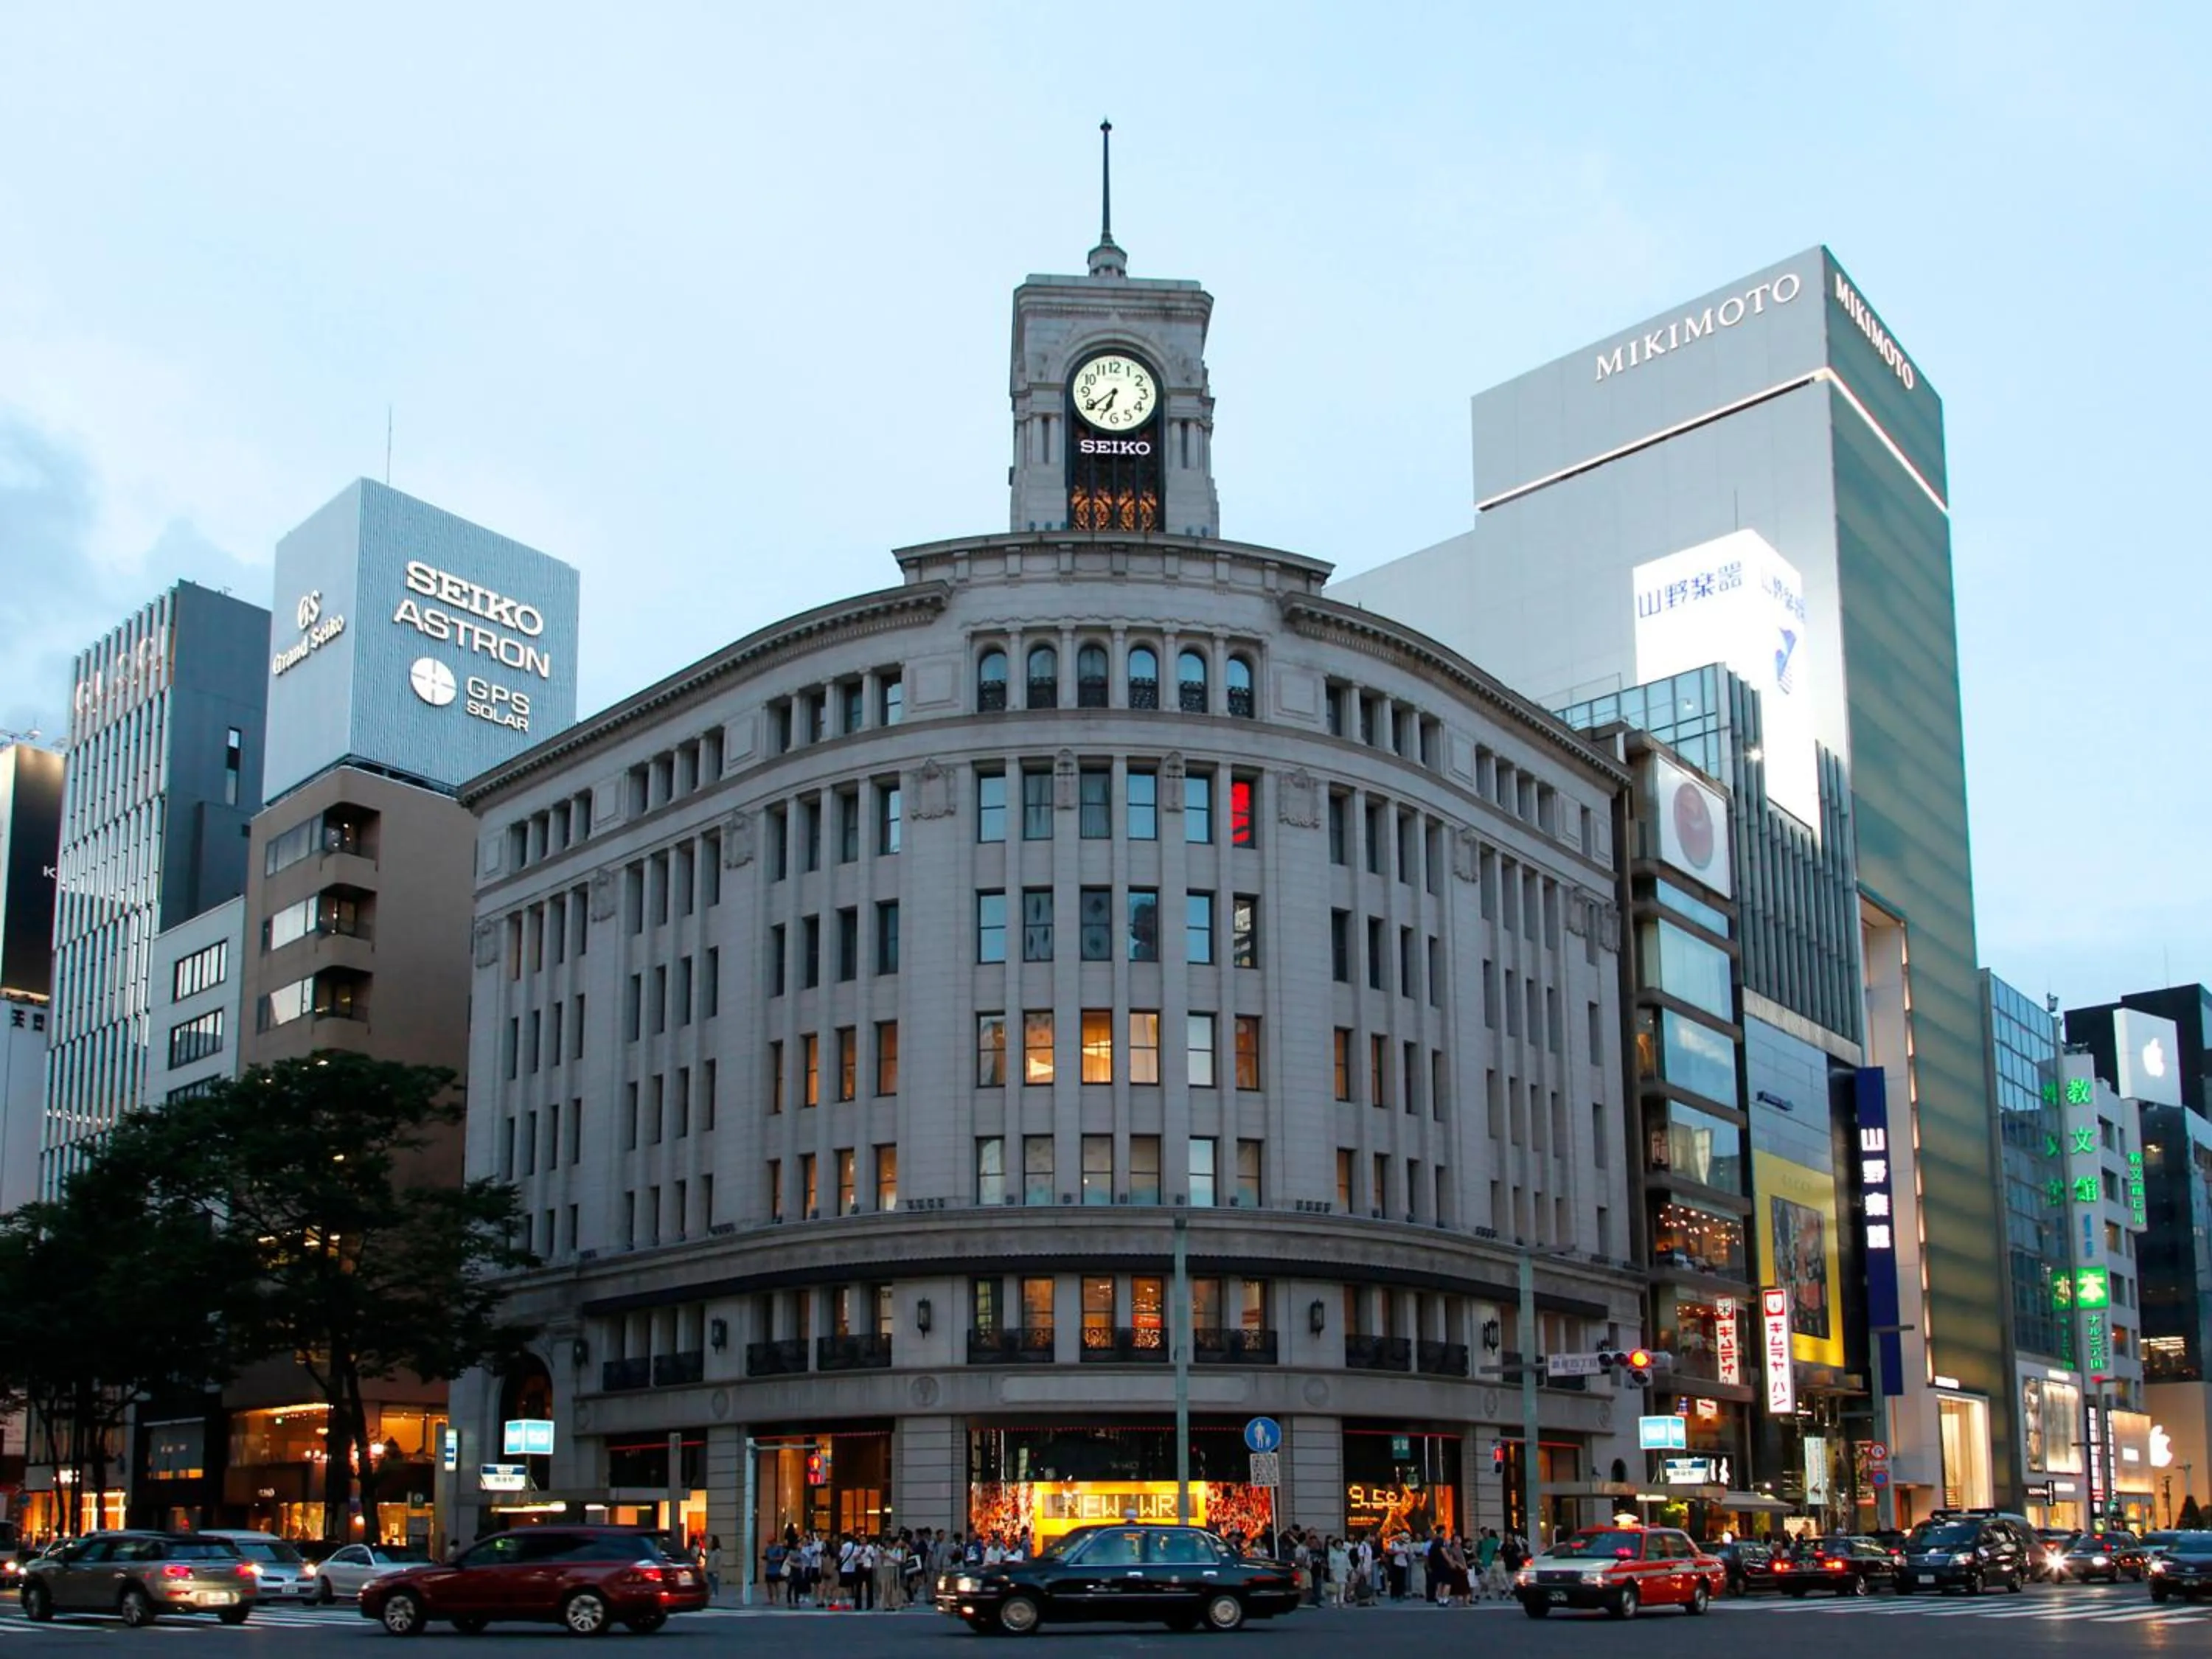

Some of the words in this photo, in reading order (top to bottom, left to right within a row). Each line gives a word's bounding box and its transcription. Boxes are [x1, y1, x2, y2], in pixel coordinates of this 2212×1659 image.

[1596, 273, 1801, 382] MIKIMOTO
[1835, 273, 1913, 390] MIKIMOTO
[1096, 364, 1106, 376] 11
[1108, 361, 1121, 374] 12
[1126, 366, 1130, 377] 1
[1085, 374, 1096, 386] 10
[1135, 375, 1144, 387] 2
[1080, 386, 1091, 397] 9
[1140, 388, 1149, 400] 3
[1123, 410, 1133, 422] 5
[1134, 401, 1144, 413] 4
[1109, 413, 1119, 424] 6
[1080, 440, 1151, 455] SEIKO
[406, 560, 544, 636] SEIKO
[1638, 560, 1742, 618] 山野楽器
[297, 590, 321, 630] GS
[272, 636, 310, 675] Grand
[310, 614, 345, 650] Seiko
[393, 599, 550, 678] ASTRON
[466, 675, 530, 715] GPS
[466, 699, 529, 732] SOLAR
[2066, 1077, 2098, 1202] 教文館
[2078, 1273, 2105, 1302] 本
[1064, 1495, 1119, 1517] NEW
[1139, 1495, 1178, 1517] WR
